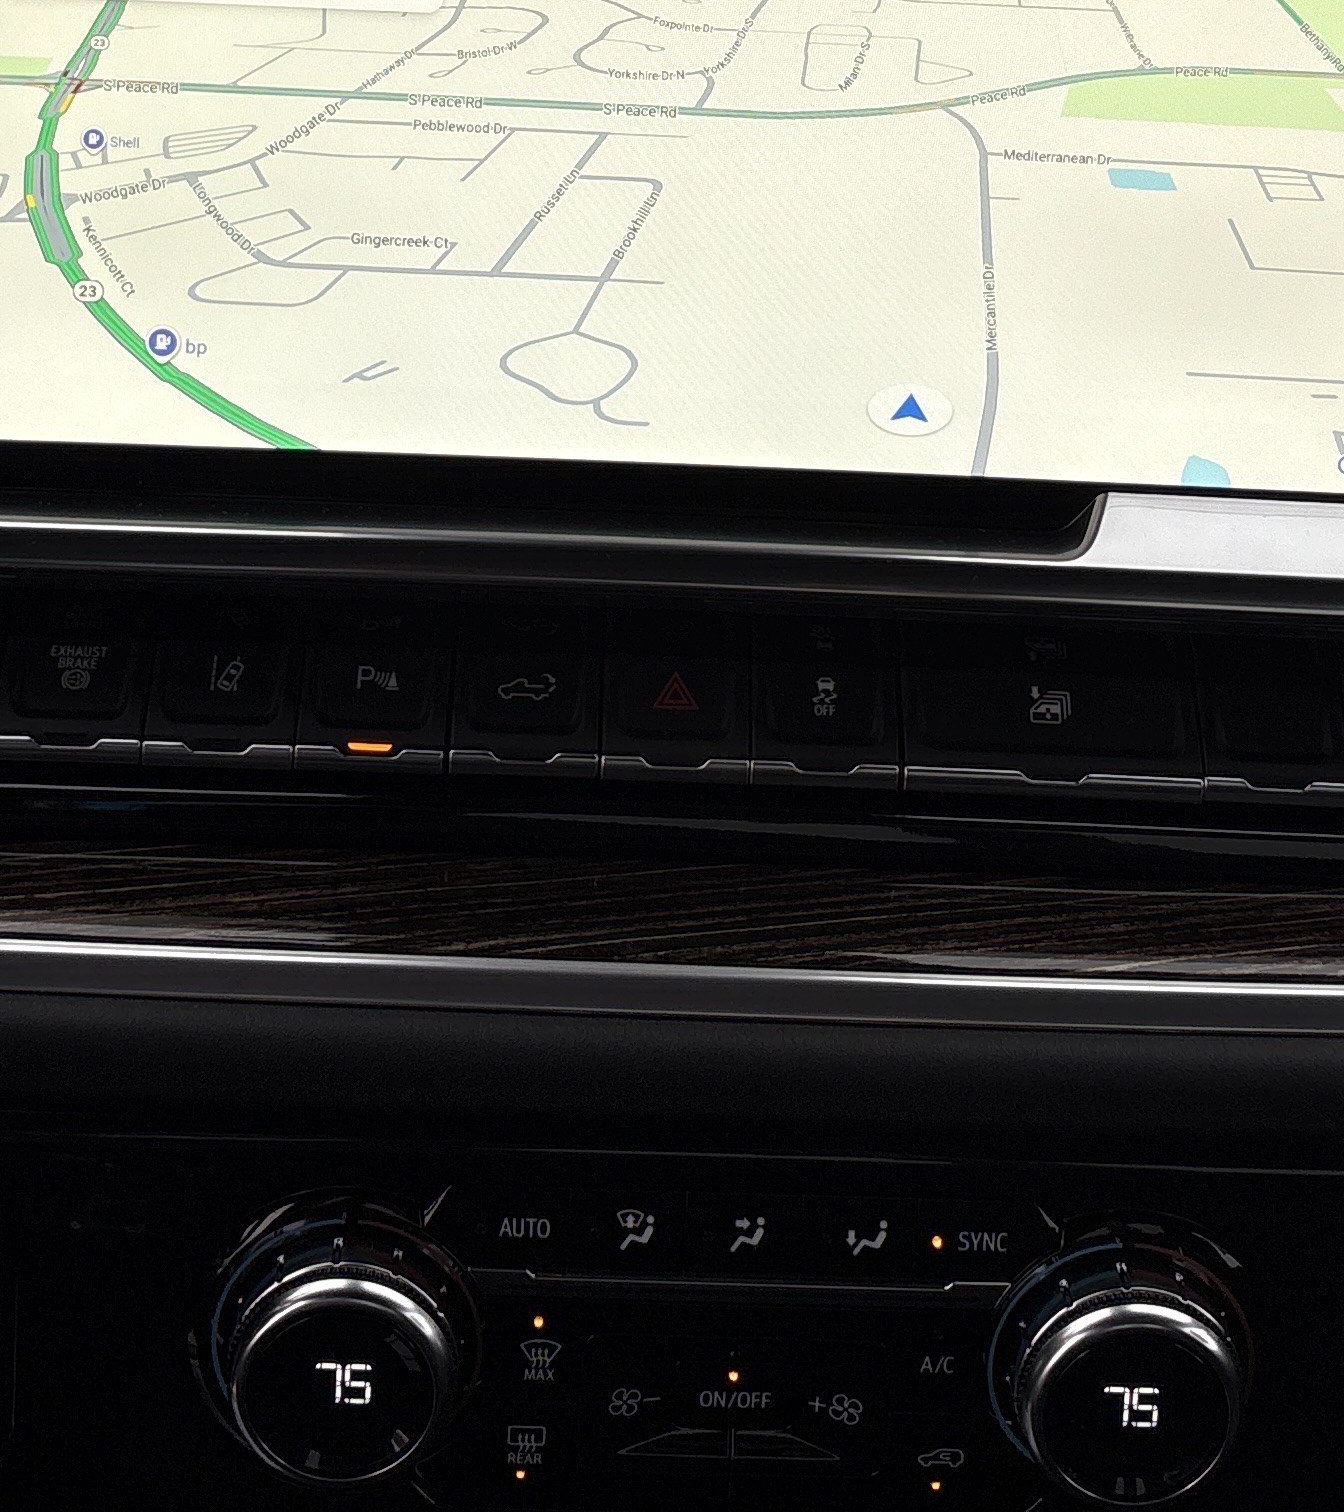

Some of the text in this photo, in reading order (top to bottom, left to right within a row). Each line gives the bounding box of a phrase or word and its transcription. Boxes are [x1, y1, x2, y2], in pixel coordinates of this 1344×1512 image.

[653, 16, 713, 33] Foxpointe Dr
[94, 38, 105, 47] 23
[457, 40, 518, 60] Bristol Dr W
[703, 18, 754, 76] Yorkshire Dr S
[1300, 23, 1335, 62] Bethany
[362, 48, 416, 89] Hathaway Dr
[608, 68, 685, 81] Yorkshire Dr N
[839, 41, 870, 92] Milan Dr S
[1175, 67, 1229, 78] Peace Rd
[103, 80, 179, 94] S Peace Rd
[970, 85, 1027, 107] Peace Rd
[409, 94, 483, 109] S Peace Rd
[603, 103, 677, 118] S Peace Rd
[265, 101, 341, 157] Woodgate Dr
[413, 119, 508, 134] Pebblewood Dr
[110, 137, 140, 149] Shell
[1002, 148, 1112, 166] Mediterranean Dr
[80, 178, 167, 204] Woodgate Dr
[534, 168, 580, 221] Russet Ln
[193, 183, 255, 255] Longwood Dr
[612, 191, 660, 261] Brookhill Ln
[351, 232, 449, 249] Gingercreek Ct
[82, 225, 136, 298] Kennicott Ct
[79, 285, 97, 298] 23
[982, 264, 997, 351] Mercantile Dr
[185, 338, 208, 357] bp
[50, 644, 109, 658] EXHAUST
[58, 656, 99, 669] BRAKE
[813, 704, 837, 717] OFF
[499, 1216, 551, 1239] AUTO
[958, 1231, 1009, 1253] SYNC
[523, 1368, 555, 1382] MAX
[920, 1355, 955, 1376] A/C
[316, 1362, 373, 1405] 75
[699, 1390, 772, 1411] ON/OFF
[1103, 1386, 1160, 1428] 75
[507, 1451, 543, 1465] REAR
